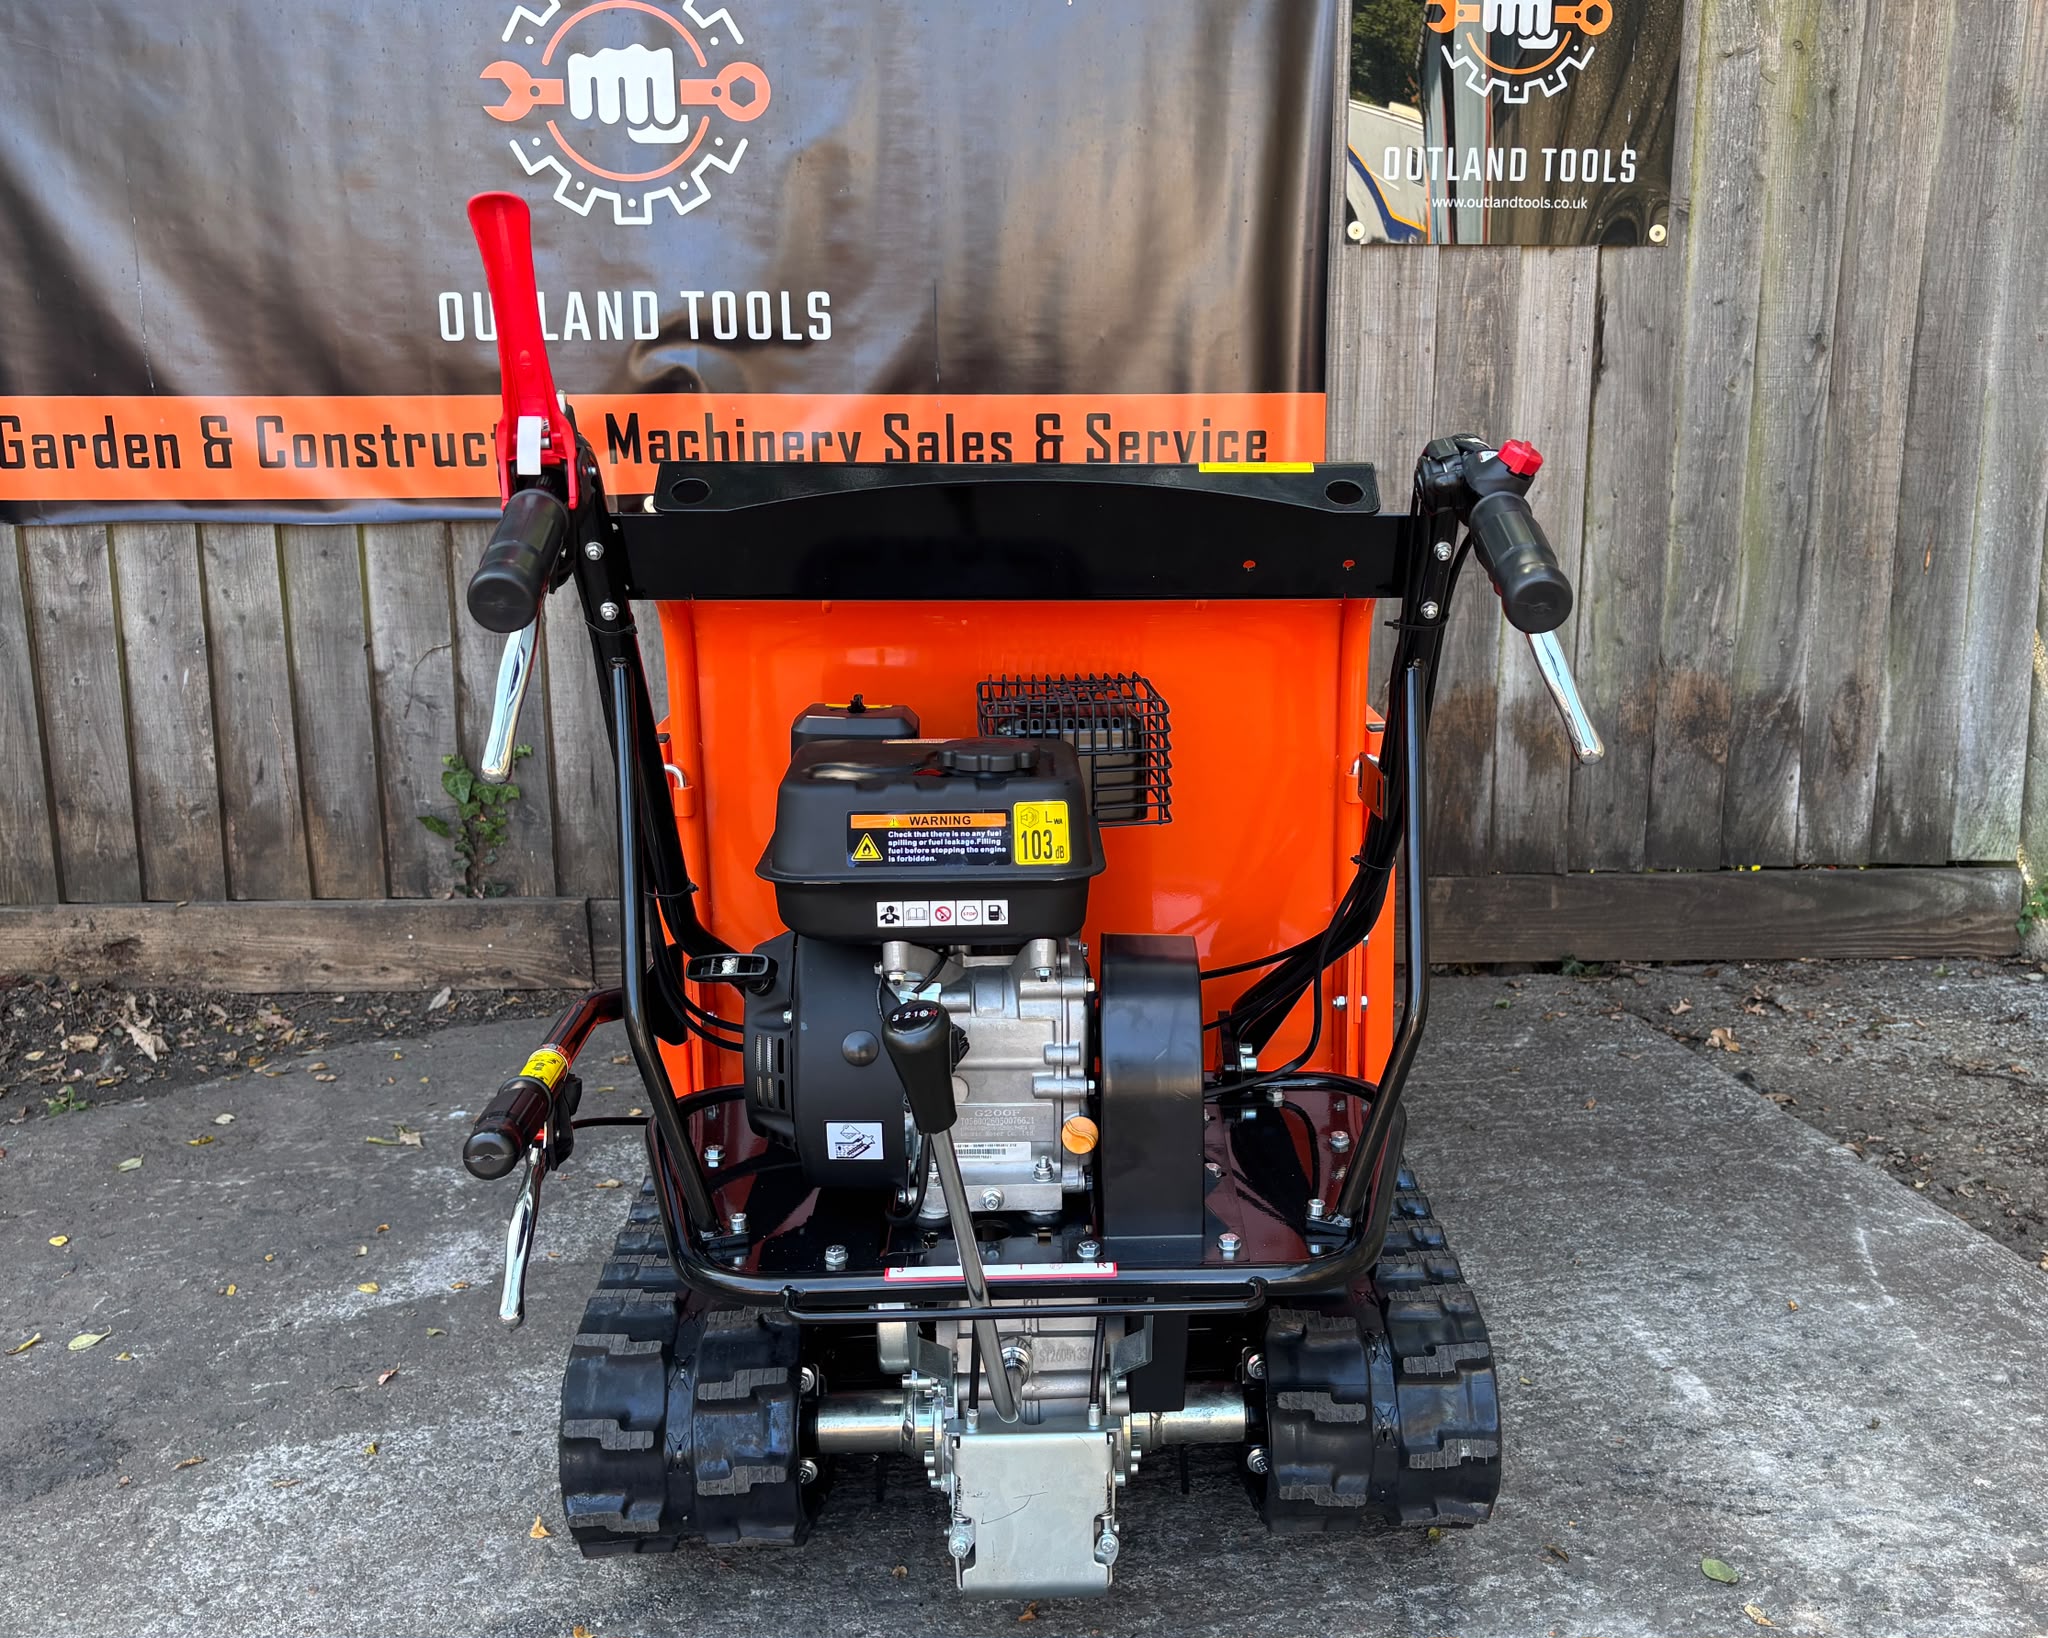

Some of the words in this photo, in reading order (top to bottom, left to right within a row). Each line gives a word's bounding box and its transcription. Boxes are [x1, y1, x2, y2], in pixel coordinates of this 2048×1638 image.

[1383, 146, 1527, 182] OUTLAND
[1541, 147, 1637, 183] TOOLS
[1431, 196, 1588, 209] www.outlandtools.co.uk
[438, 290, 661, 342] OULAND
[680, 290, 832, 341] TOOLS
[0, 415, 181, 469] Garden
[200, 416, 233, 469] &
[255, 415, 498, 469] Construc
[883, 413, 1012, 464] Sales
[1035, 413, 1064, 464] &
[1086, 412, 1267, 464] Service
[909, 815, 972, 826] WARNING
[888, 830, 912, 838] Check
[914, 830, 929, 838] that
[930, 830, 950, 838] there
[888, 839, 917, 847] spilling
[1021, 829, 1053, 860] 103
[1055, 845, 1065, 859] dB
[931, 846, 965, 855] stopping
[980, 846, 1007, 854] engine
[974, 1109, 1021, 1117] G200F
